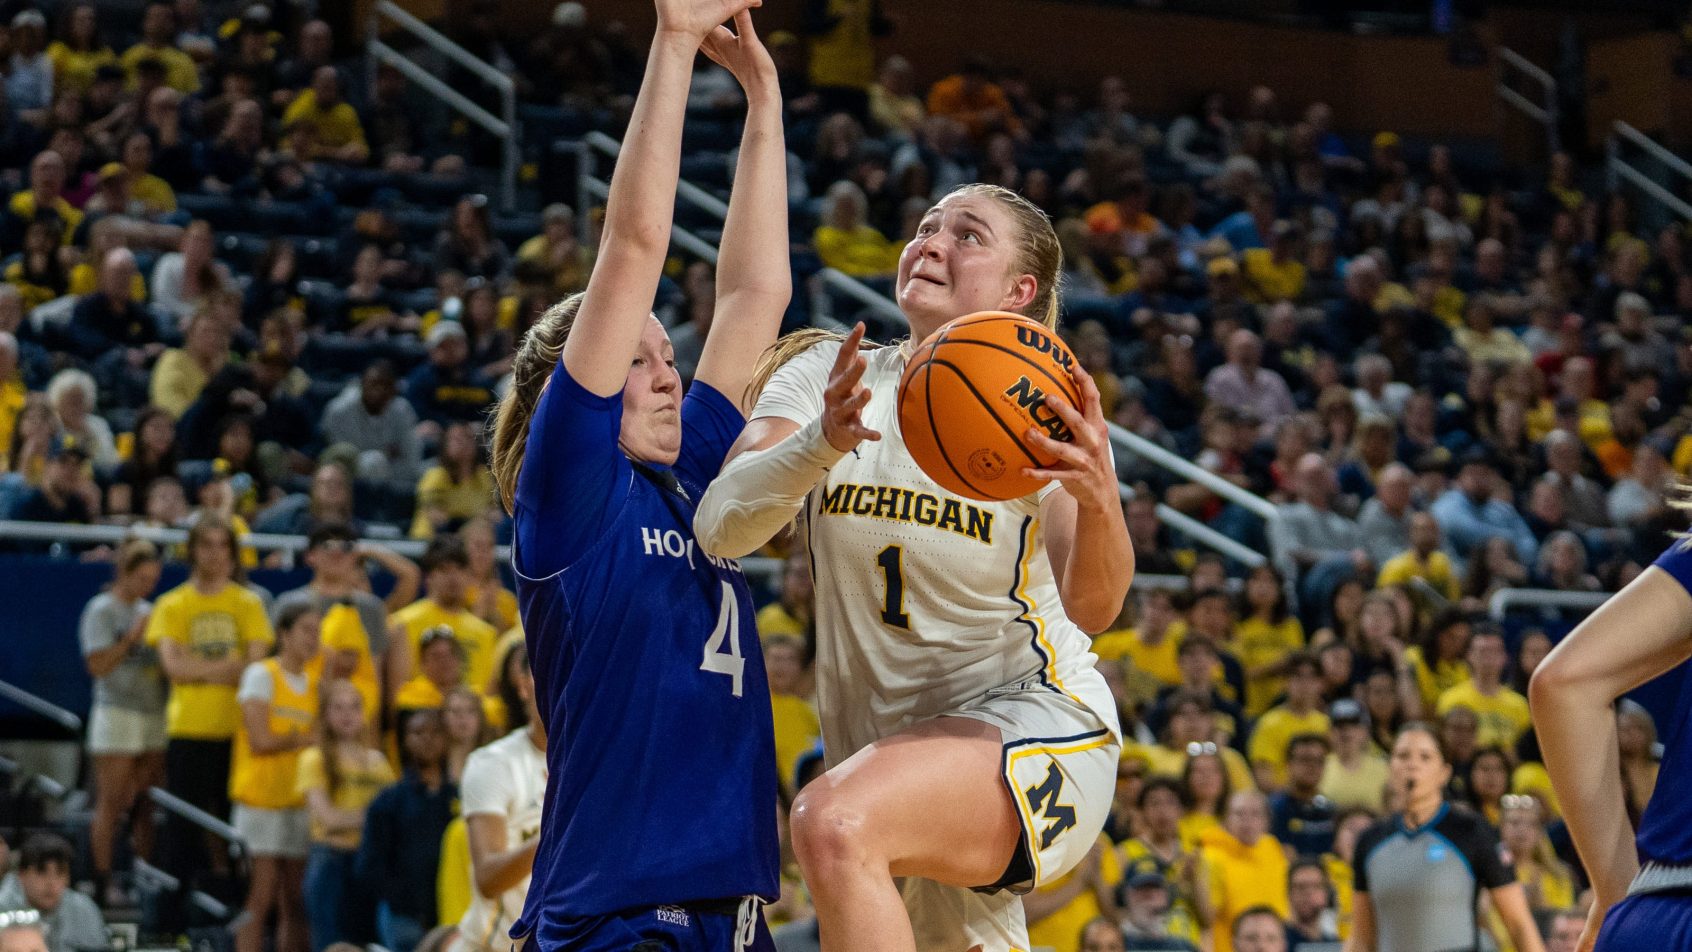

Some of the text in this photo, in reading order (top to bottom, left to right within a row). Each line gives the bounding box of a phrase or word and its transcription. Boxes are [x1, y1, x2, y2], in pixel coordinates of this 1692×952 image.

[818, 484, 995, 546] MICHIGAN
[877, 544, 912, 631] 1
[699, 580, 746, 698] 4
[1025, 760, 1077, 852] M
[656, 909, 689, 921] PATRIOT
[657, 914, 690, 927] LEAGUE
